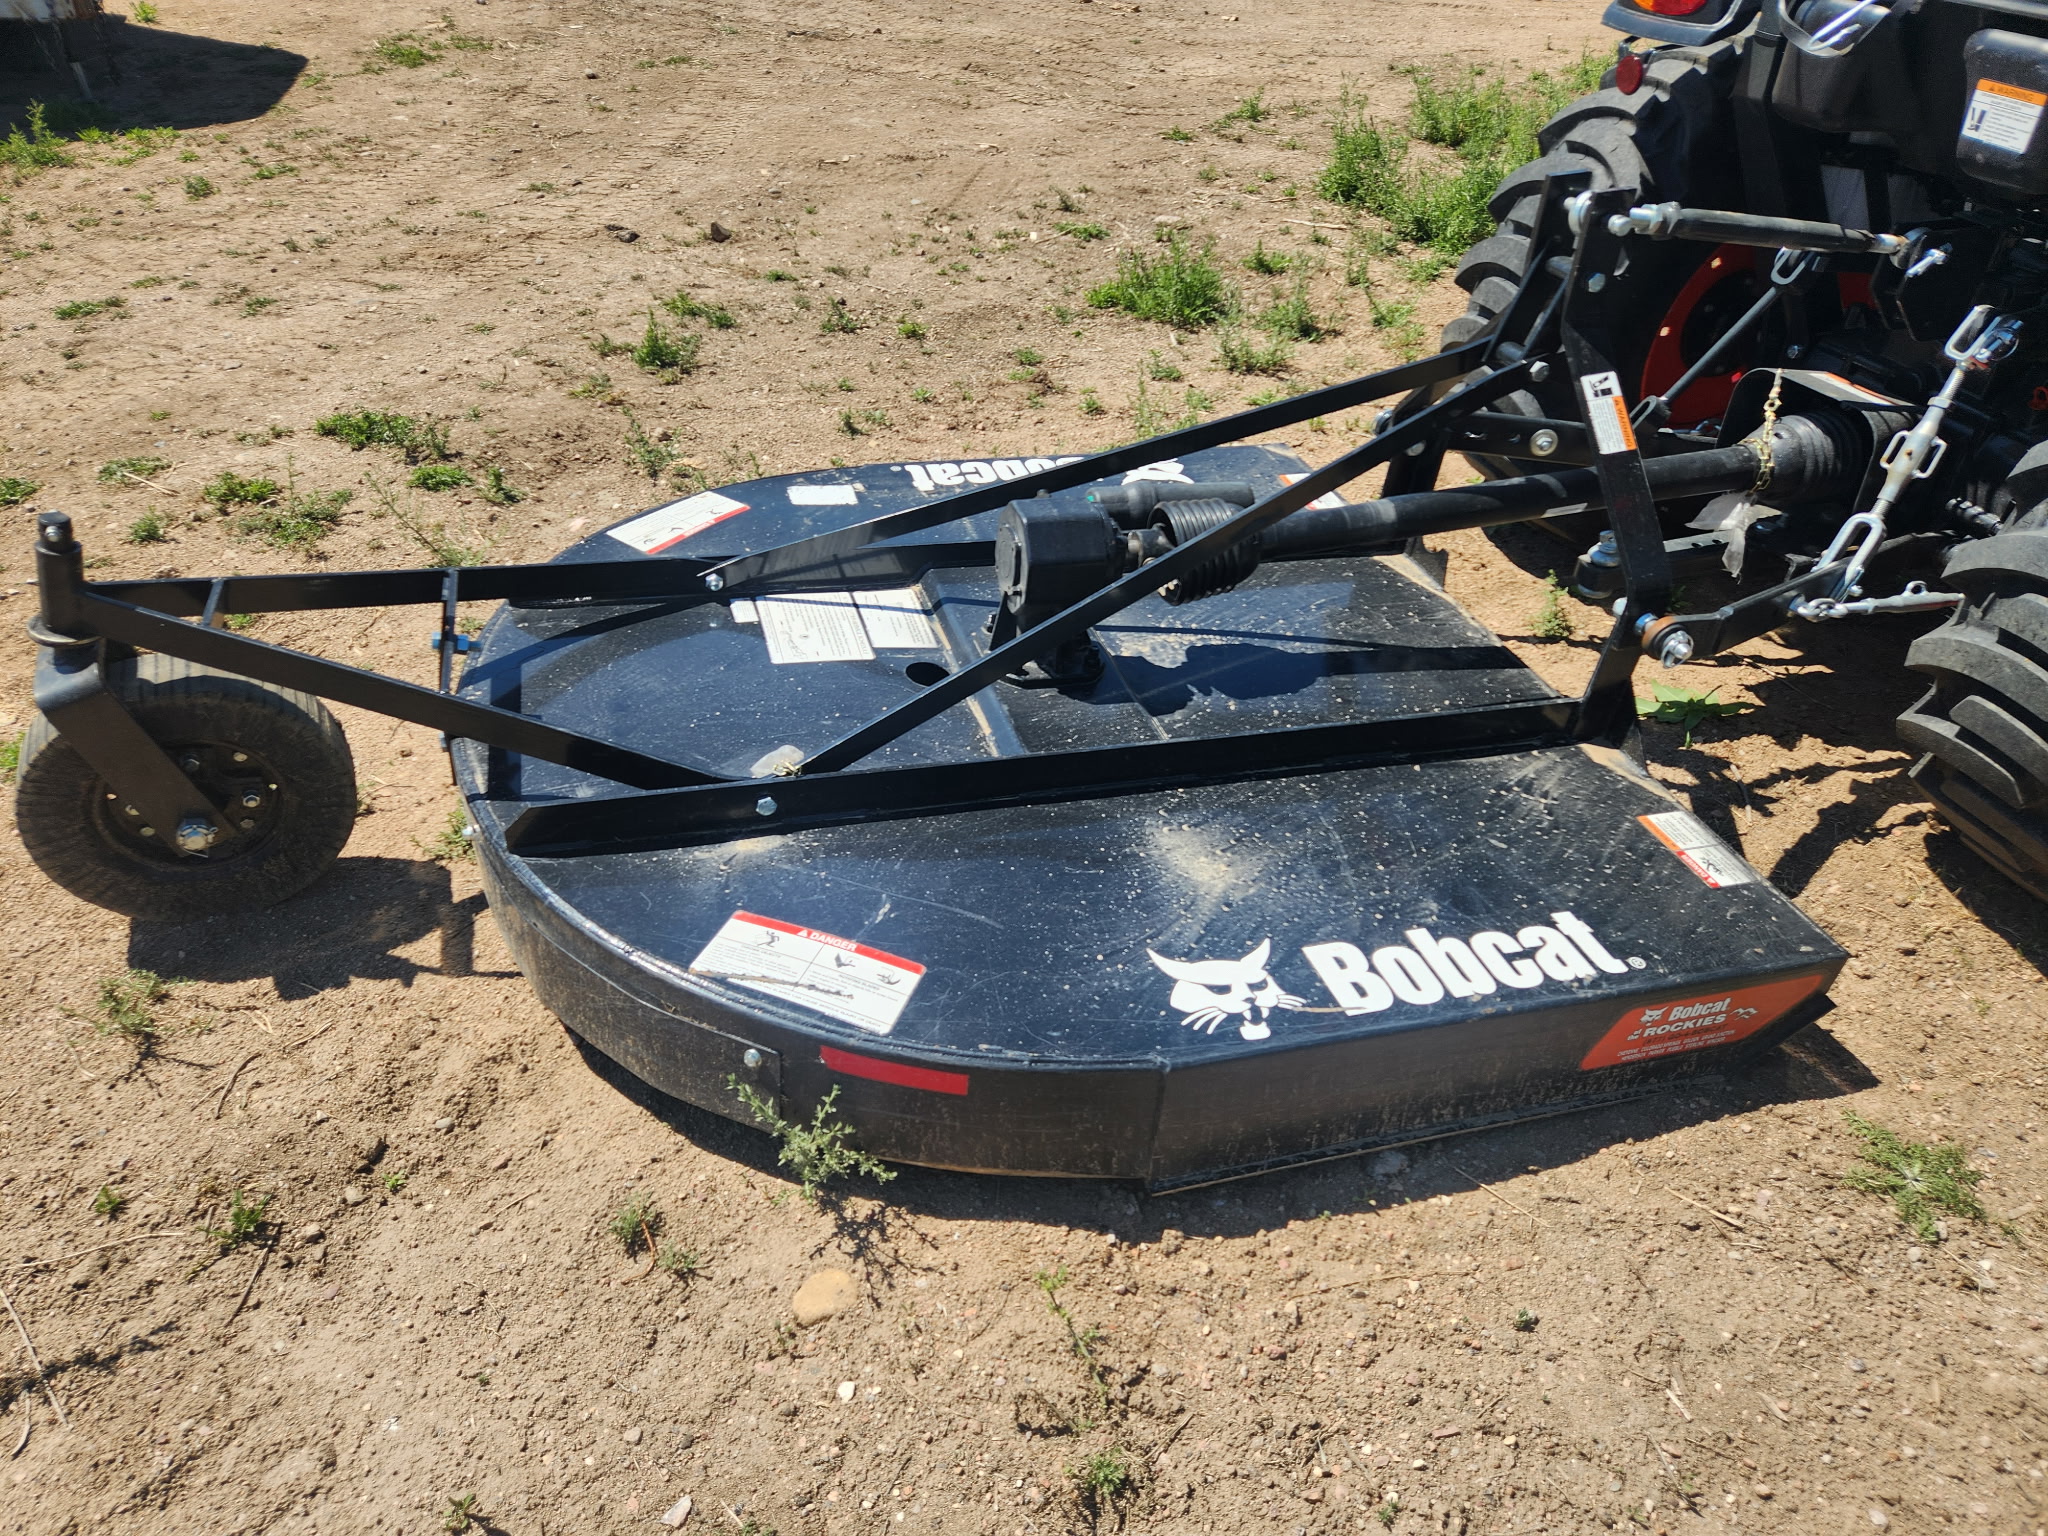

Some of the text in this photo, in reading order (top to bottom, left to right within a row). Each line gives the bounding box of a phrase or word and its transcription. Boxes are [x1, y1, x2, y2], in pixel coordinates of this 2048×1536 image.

[810, 931, 857, 952] DANGER
[1302, 911, 1629, 1016] Bobcat
[1668, 998, 1731, 1021] Bobcat
[1642, 1013, 1727, 1038] ROCKIES
